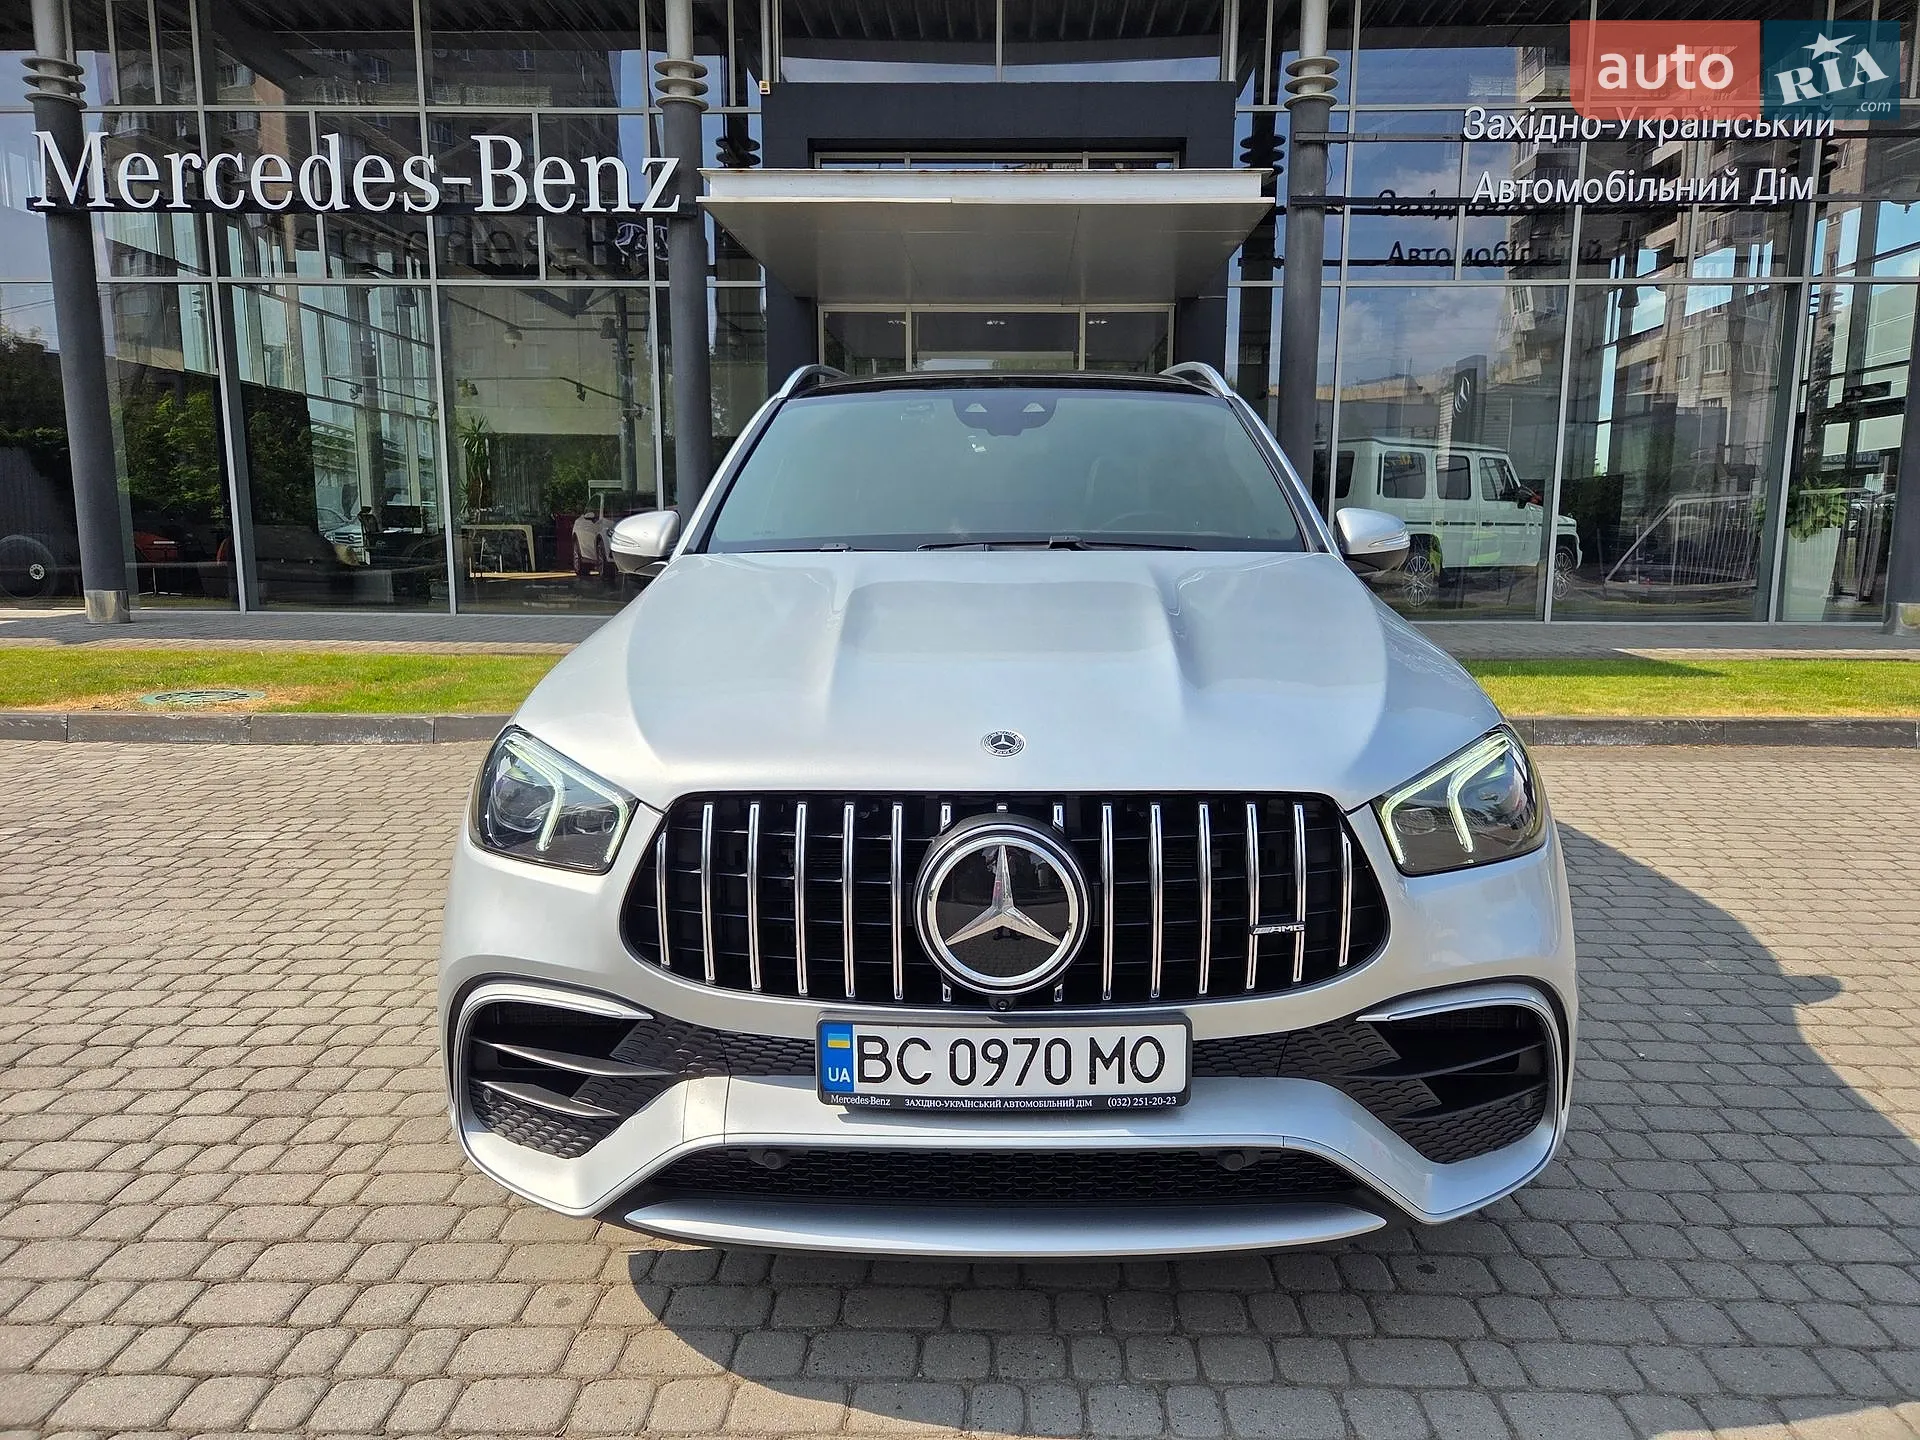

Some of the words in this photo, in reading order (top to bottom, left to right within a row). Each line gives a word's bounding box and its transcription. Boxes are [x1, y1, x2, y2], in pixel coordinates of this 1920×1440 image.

[1462, 103, 1835, 147] Західно-Український
[32, 131, 680, 213] Mercedes-Benz
[1471, 168, 1740, 205] Автомобільний
[1749, 167, 1815, 205] Дім
[1270, 924, 1304, 933] AMG
[857, 1035, 932, 1085] BC
[949, 1037, 1072, 1087] 0970
[1089, 1036, 1166, 1085] MO
[828, 1067, 851, 1083] UA
[830, 1094, 891, 1106] Mercedes-Benz
[904, 1097, 1002, 1109] ЗАХІДНО-УКРАЇНСЬКИЙ
[1002, 1098, 1075, 1108] АВТОМОБІЛЬНИЙ
[1075, 1099, 1093, 1108] ДІМ
[1107, 1096, 1131, 1107] (032)
[1132, 1096, 1177, 1106] 251-20-23
